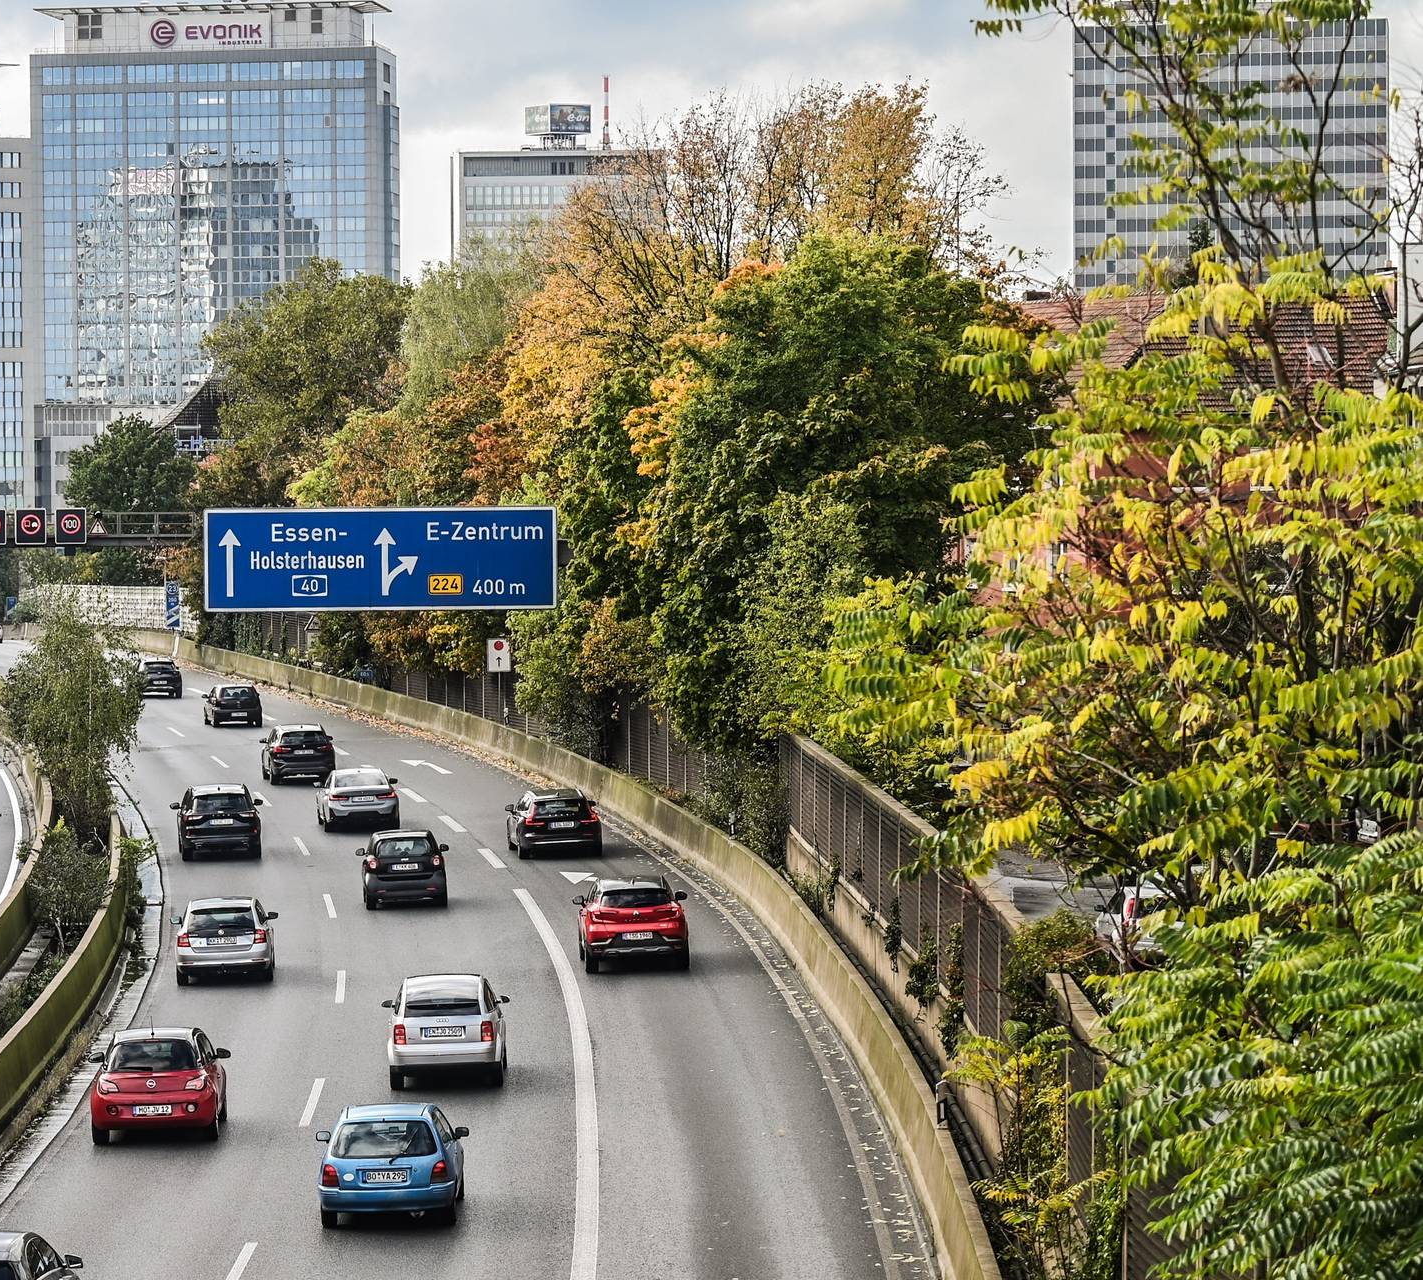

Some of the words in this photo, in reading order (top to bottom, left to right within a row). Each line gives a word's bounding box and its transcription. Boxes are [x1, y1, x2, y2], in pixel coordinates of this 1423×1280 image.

[185, 24, 262, 40] EVONIK
[64, 519, 77, 529] 100
[426, 522, 544, 541] E-Zentrum
[271, 523, 348, 543] Essen-
[250, 551, 365, 570] Holsterhausen
[301, 579, 319, 593] 40
[432, 578, 459, 591] 224
[472, 580, 505, 595] 400
[509, 583, 526, 595] m
[392, 1172, 407, 1180] 295
